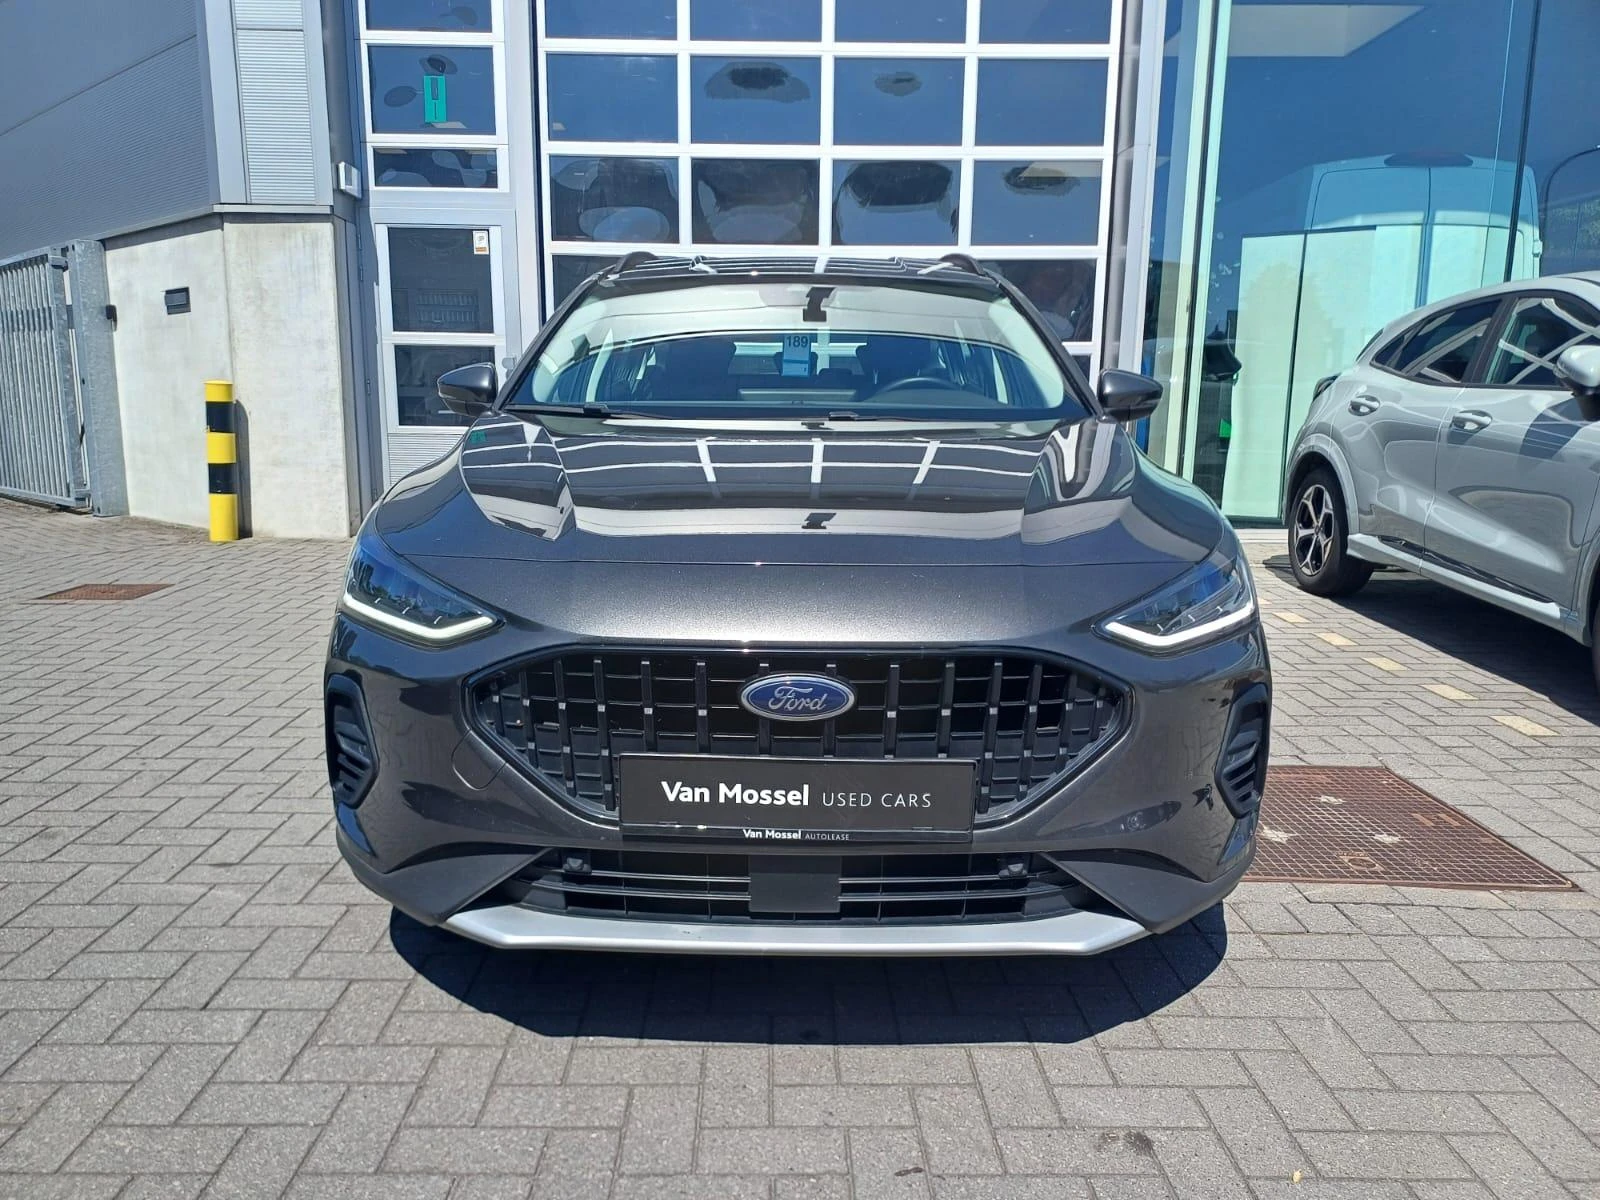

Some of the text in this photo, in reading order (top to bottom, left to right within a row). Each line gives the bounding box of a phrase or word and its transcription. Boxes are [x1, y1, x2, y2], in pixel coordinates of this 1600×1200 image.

[786, 335, 809, 348] 189
[768, 686, 828, 711] Ford
[661, 781, 932, 808] Van Mossel USED CARS
[743, 829, 850, 841] Van Mossel AUTOLEASE
